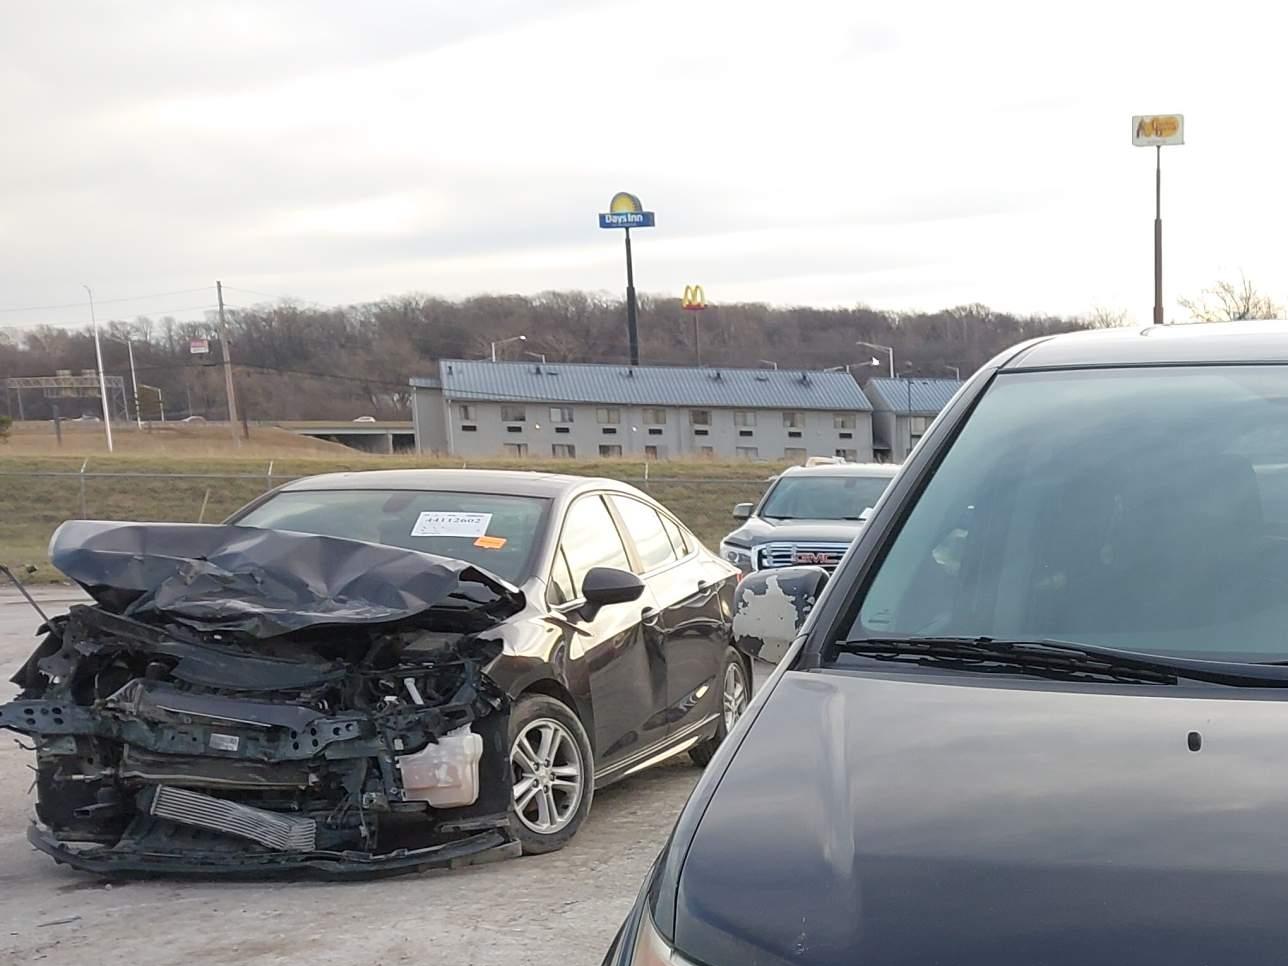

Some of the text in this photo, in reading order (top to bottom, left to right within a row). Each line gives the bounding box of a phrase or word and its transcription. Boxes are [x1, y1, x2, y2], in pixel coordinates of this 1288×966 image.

[605, 213, 644, 225] Days Inn
[797, 552, 838, 564] GMC
